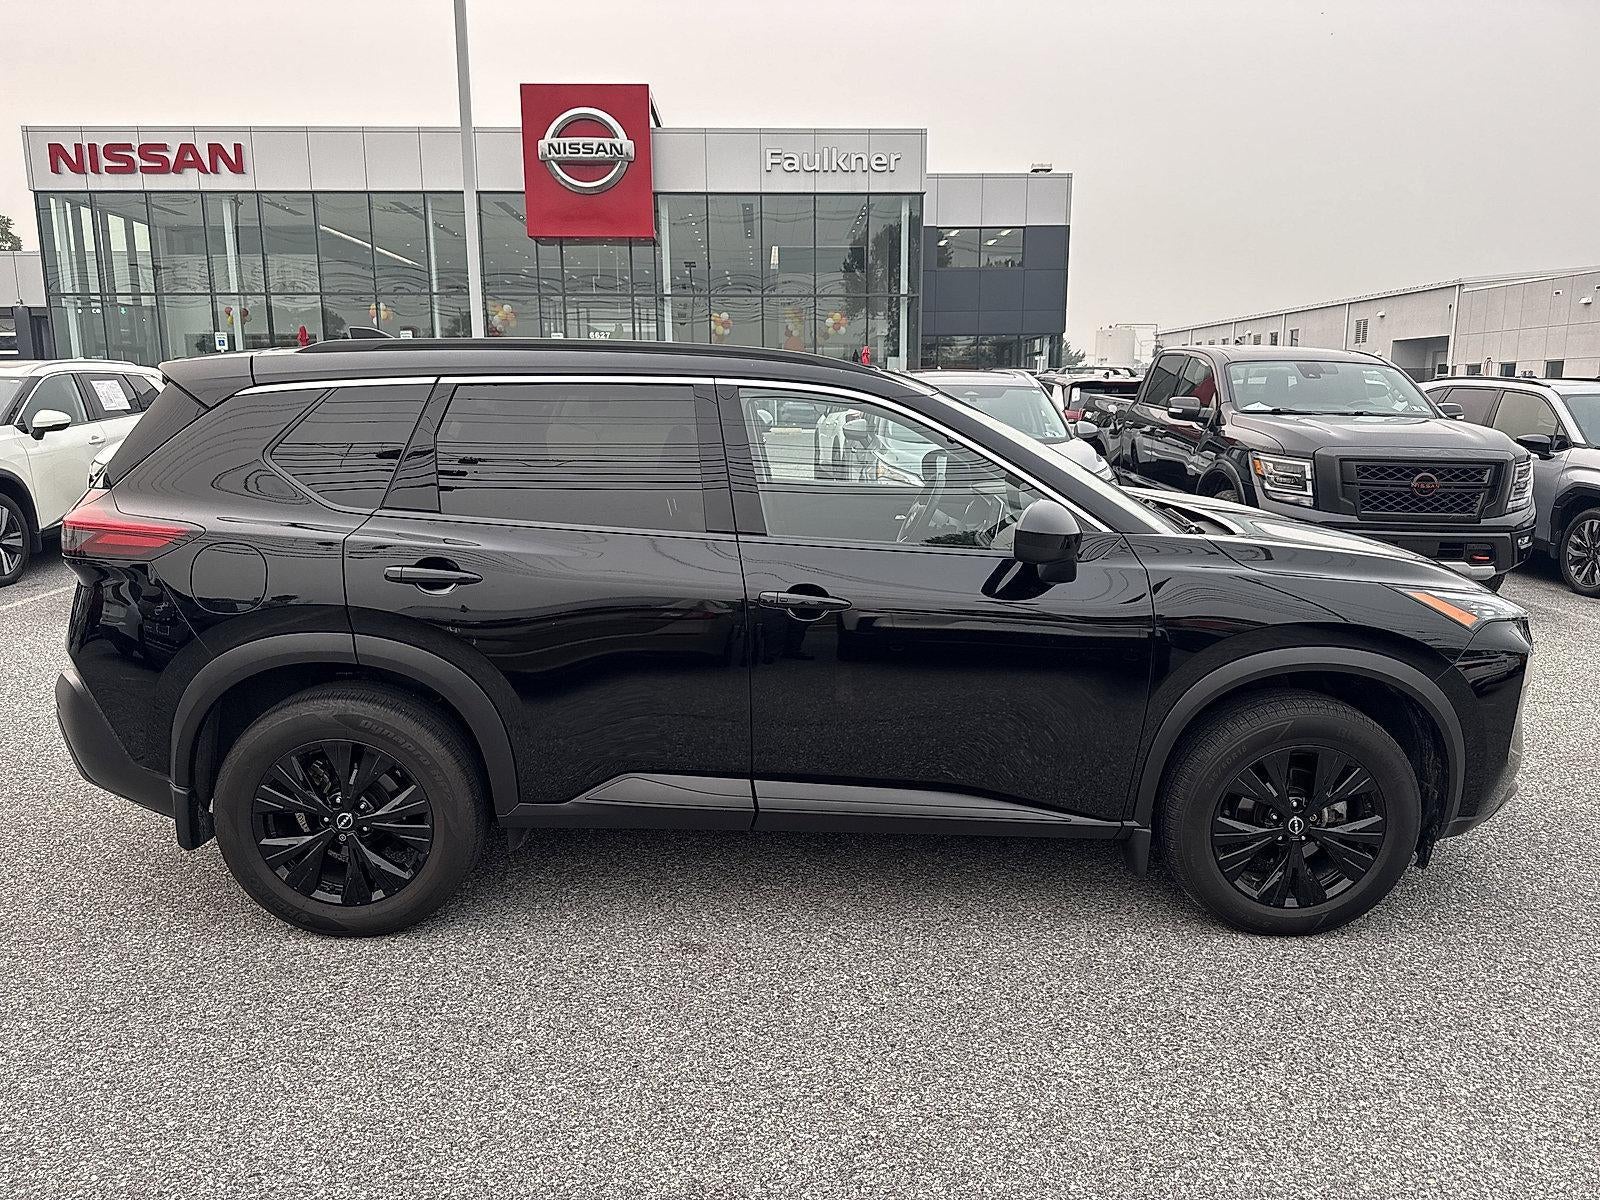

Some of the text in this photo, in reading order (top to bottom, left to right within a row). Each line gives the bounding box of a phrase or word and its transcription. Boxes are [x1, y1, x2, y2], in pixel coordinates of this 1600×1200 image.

[48, 143, 245, 175] NISSAN
[548, 142, 624, 157] NISSAN
[765, 147, 902, 173] Faulkner
[589, 331, 611, 339] 6627
